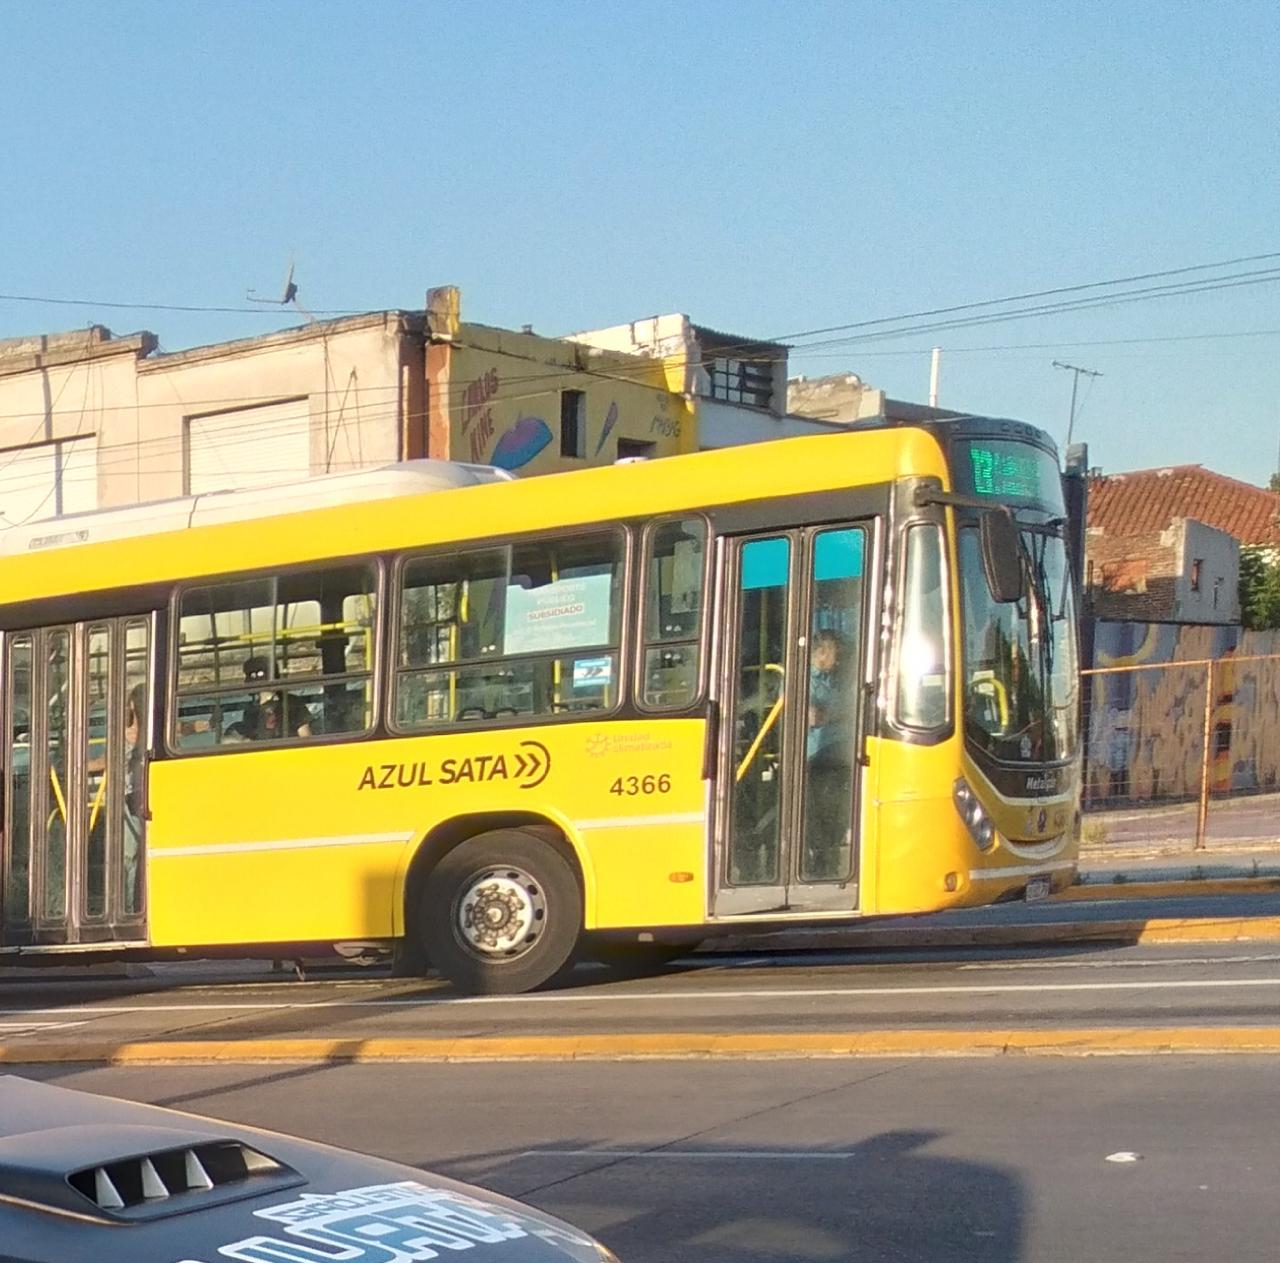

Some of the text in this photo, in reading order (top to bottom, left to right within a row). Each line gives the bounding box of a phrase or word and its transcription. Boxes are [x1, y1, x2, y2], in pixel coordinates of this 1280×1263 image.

[357, 754, 509, 791] AZUL SATA
[609, 773, 671, 796] 4366
